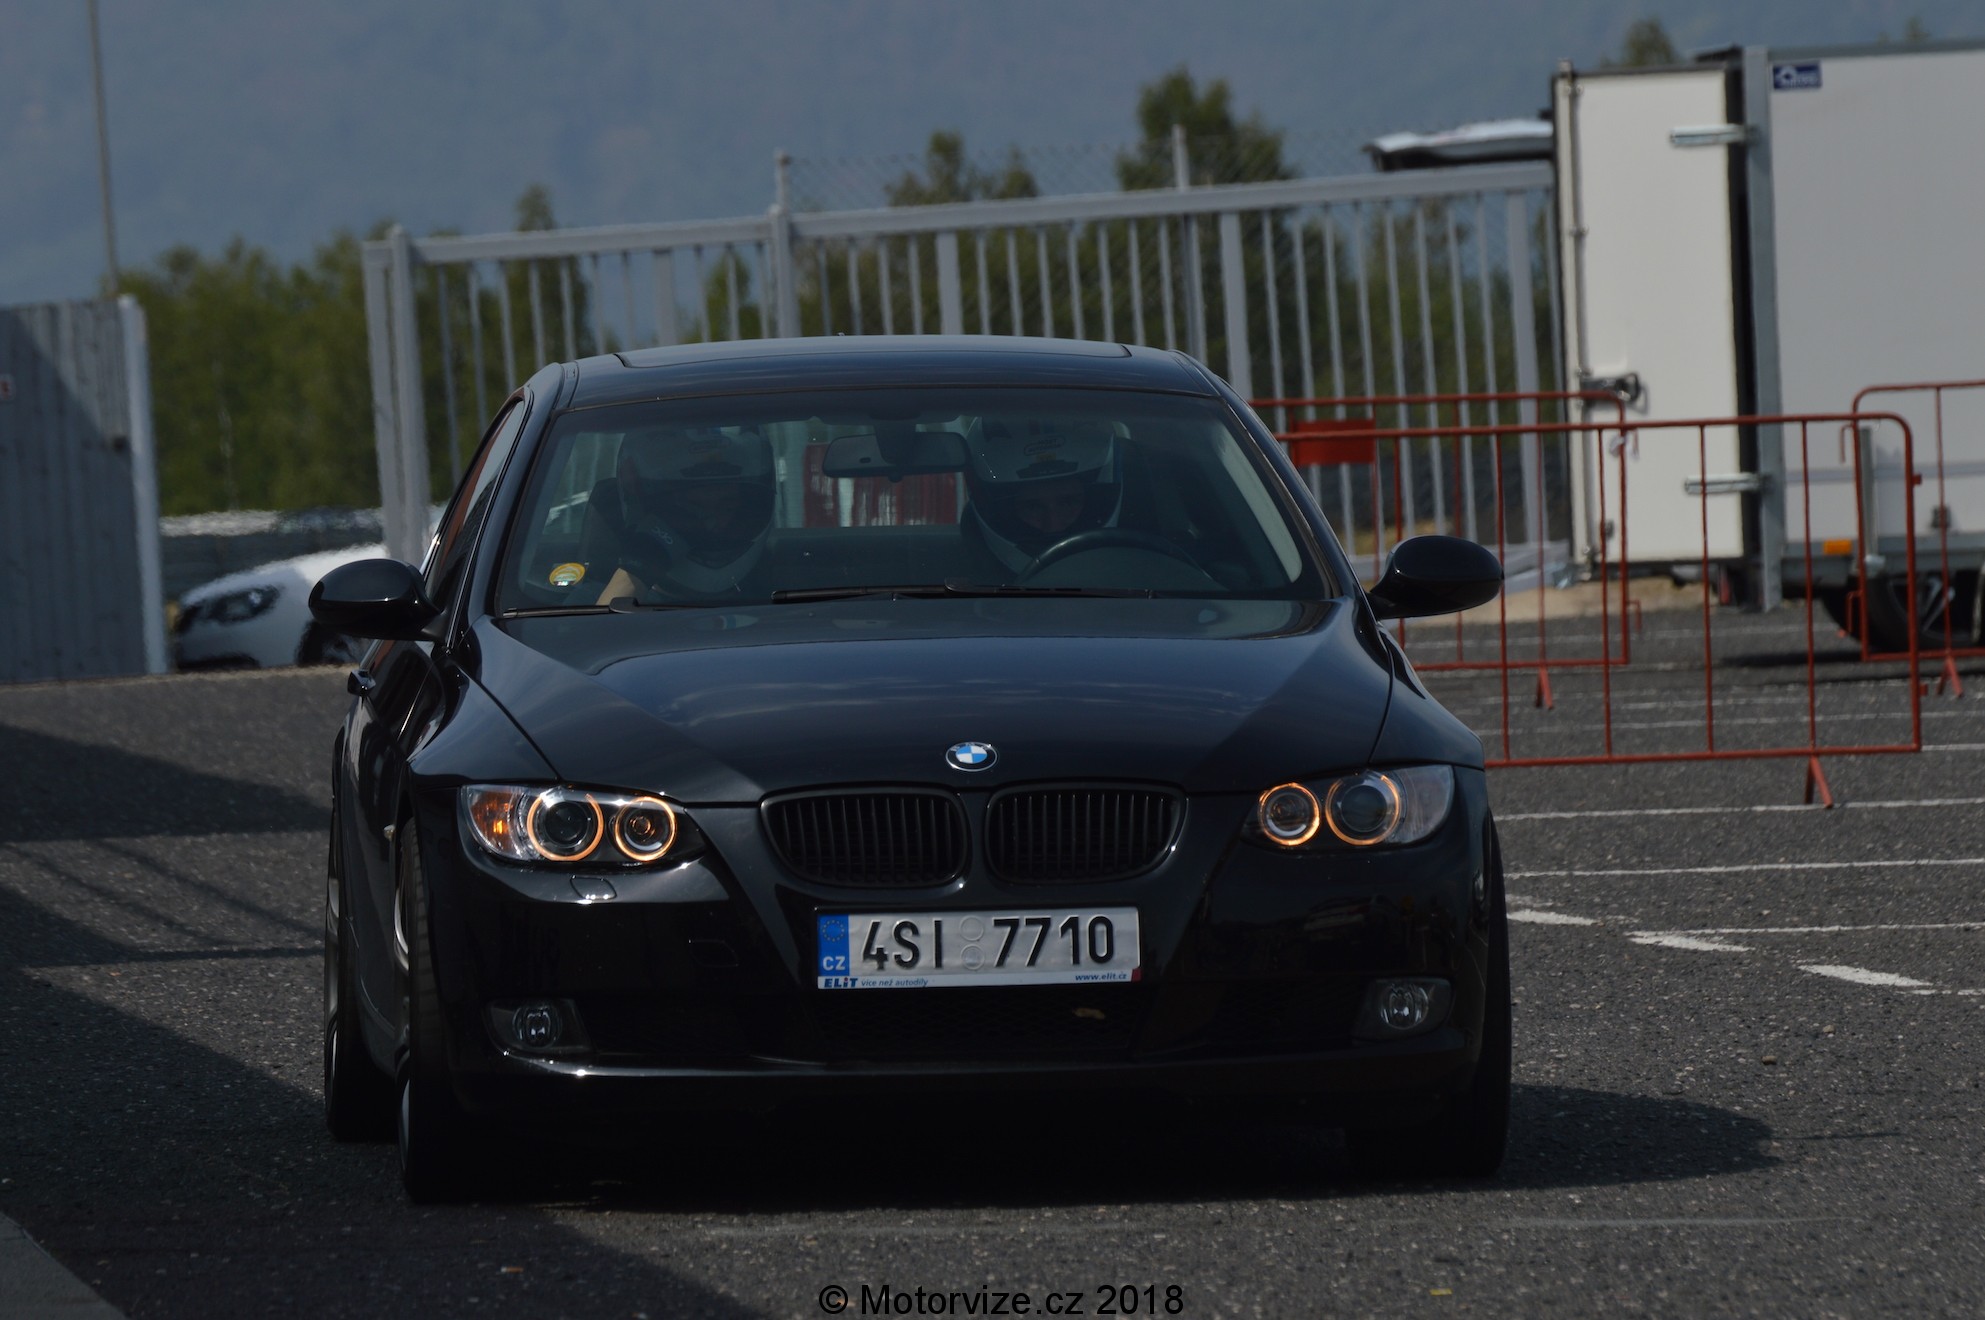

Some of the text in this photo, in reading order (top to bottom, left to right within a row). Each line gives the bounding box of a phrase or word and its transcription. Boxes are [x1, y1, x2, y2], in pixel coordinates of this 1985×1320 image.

[862, 915, 1114, 971] 4SI 7710
[822, 956, 846, 971] CZ
[1075, 972, 1127, 981] www.elit.cz
